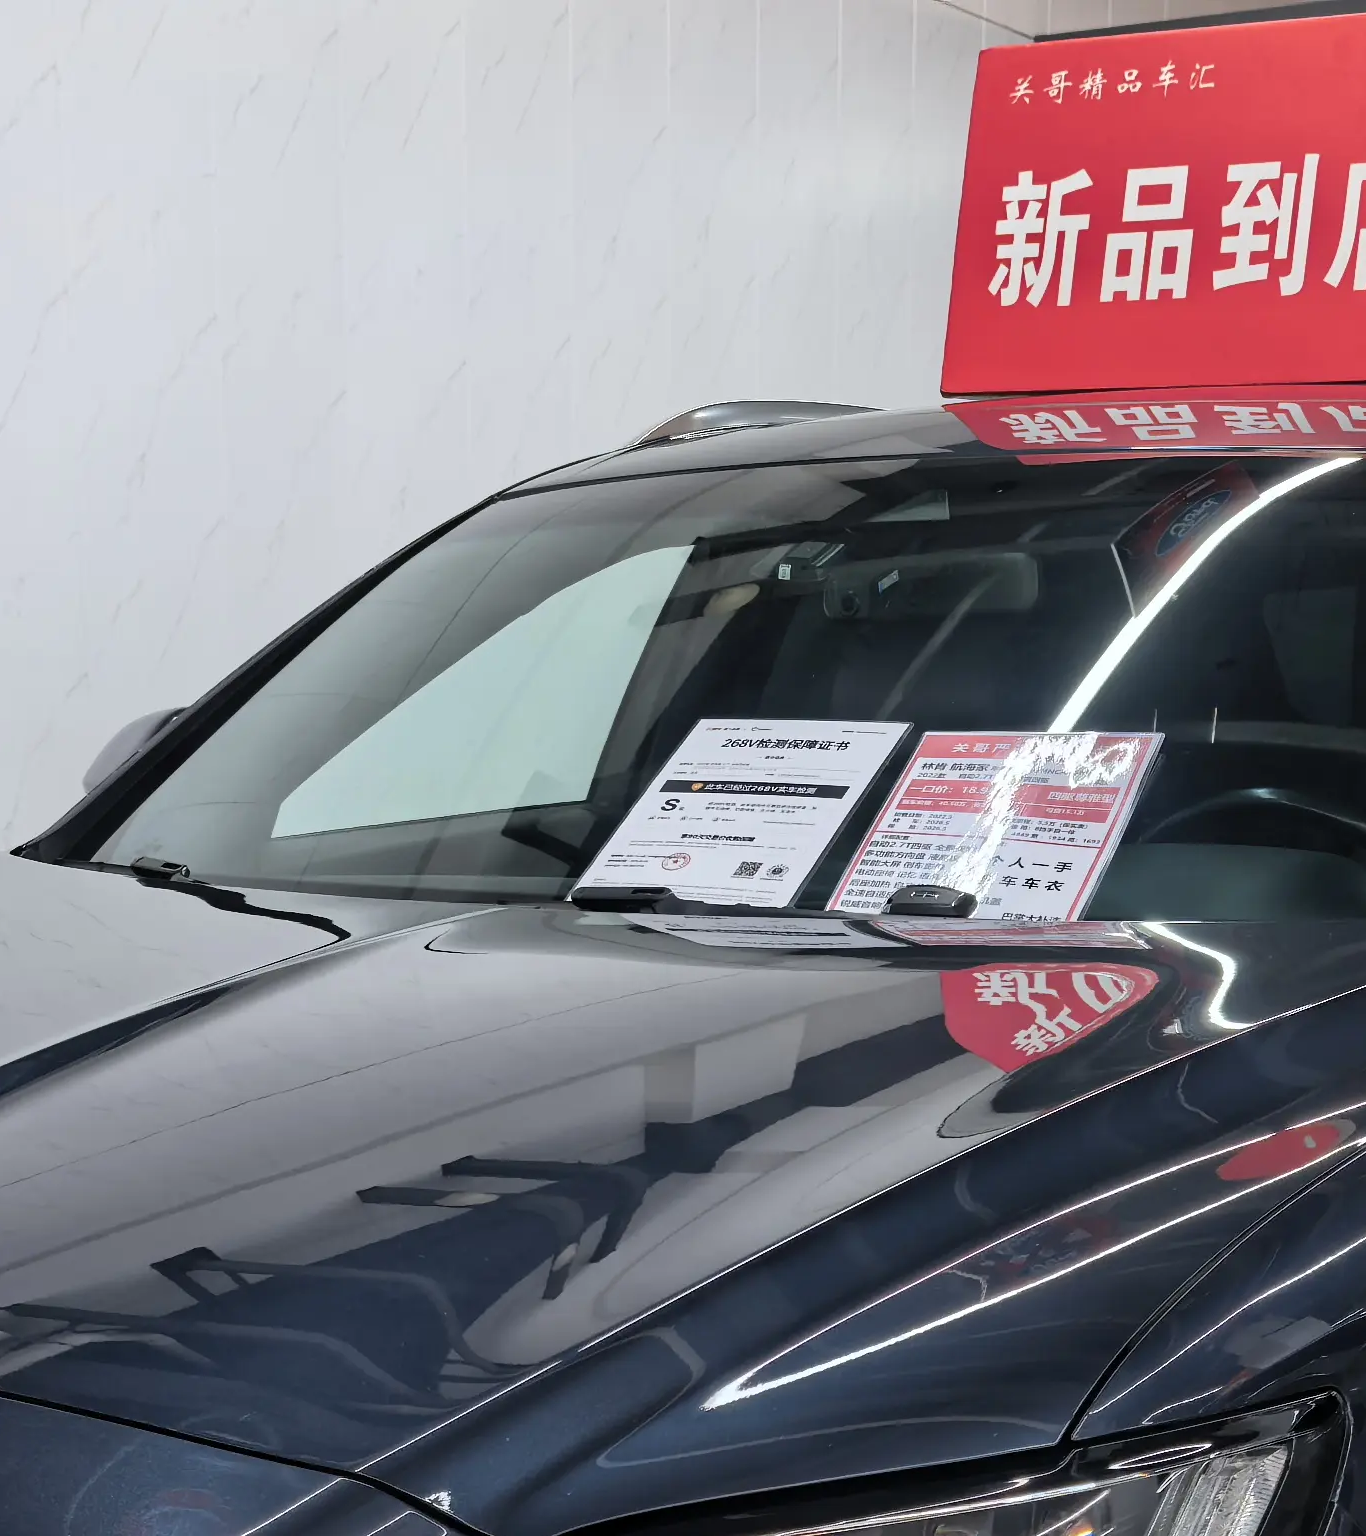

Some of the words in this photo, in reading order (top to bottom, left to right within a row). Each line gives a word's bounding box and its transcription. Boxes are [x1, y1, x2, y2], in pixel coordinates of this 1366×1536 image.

[1009, 60, 1217, 105] 关哥精品车汇
[721, 738, 851, 751] 268V检测保障证书
